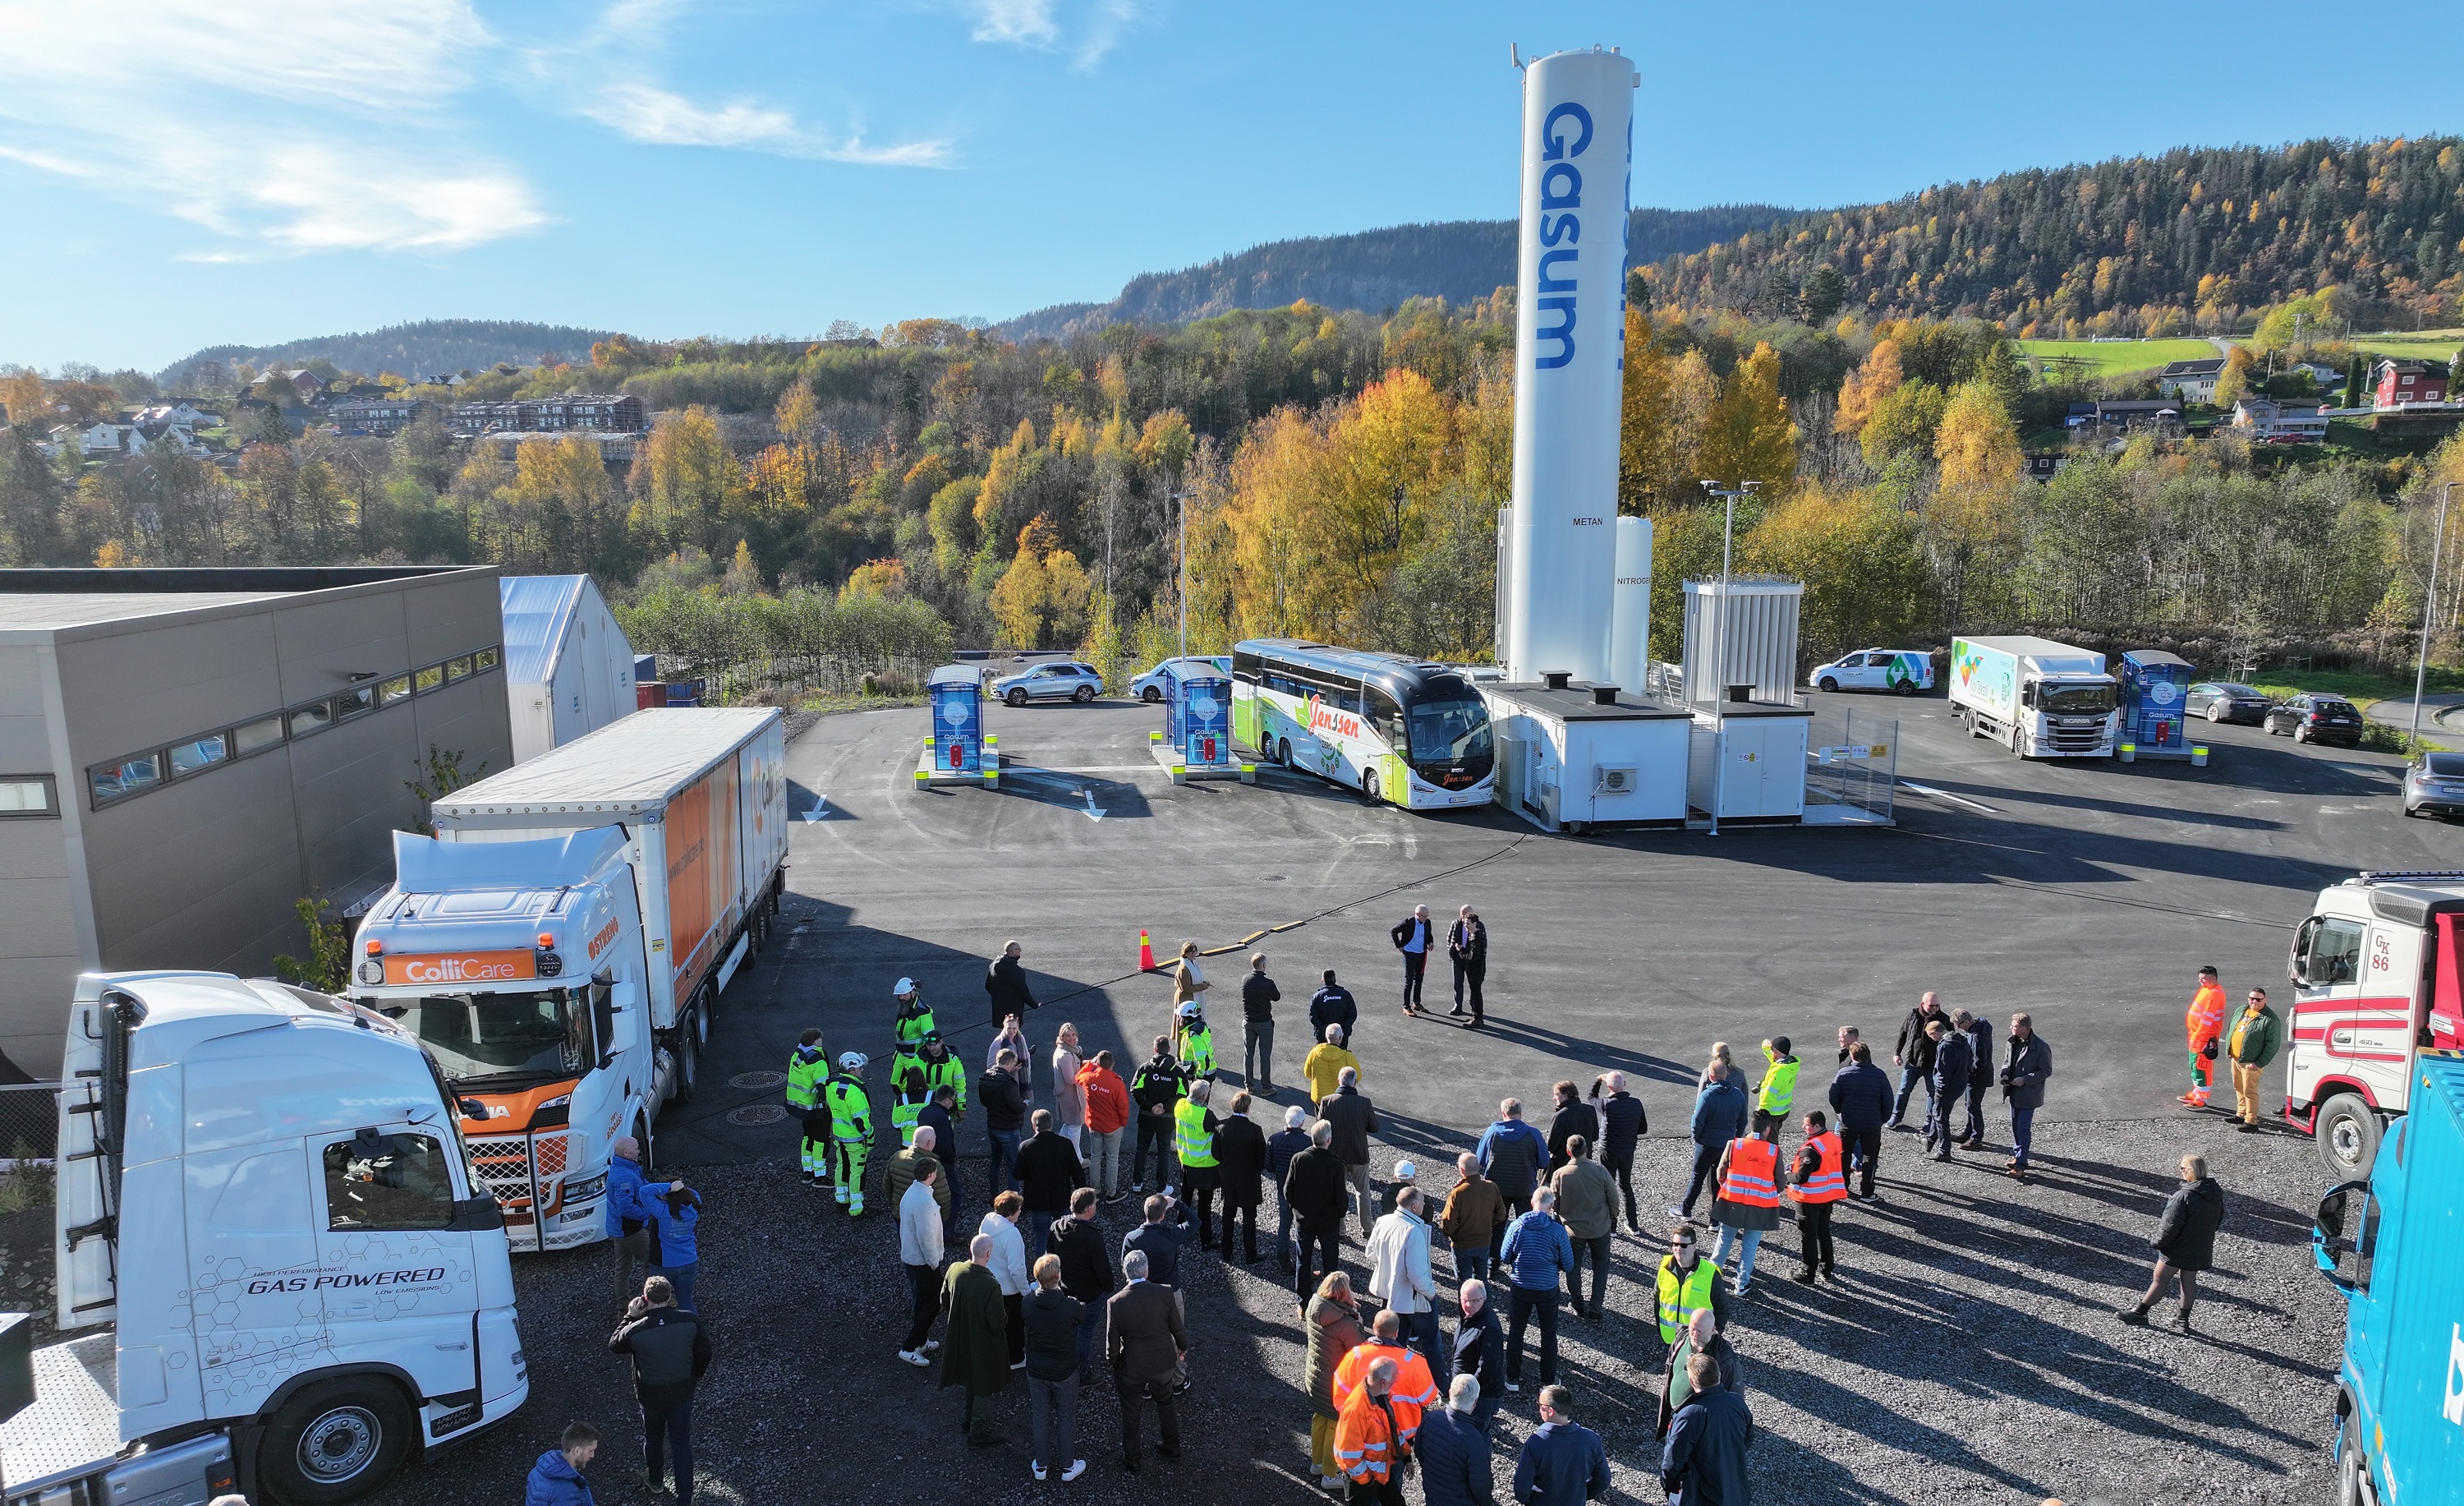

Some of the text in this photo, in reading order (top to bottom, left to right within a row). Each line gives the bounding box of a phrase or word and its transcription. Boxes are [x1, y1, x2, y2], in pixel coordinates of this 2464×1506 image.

[1535, 102, 1593, 370] Gasum
[1573, 518, 1603, 526] METAN
[1307, 693, 1359, 739] Jenssen
[1322, 739, 1333, 750] ZERO
[1442, 773, 1473, 786] Jenssen
[587, 915, 619, 960] ØSTRENG
[406, 958, 515, 982] ColliCare
[2372, 954, 2389, 971] 86
[276, 1266, 345, 1275] PERFORMANCE
[247, 1267, 445, 1295] GAS POWERED
[395, 1285, 440, 1293] EMISSIONS
